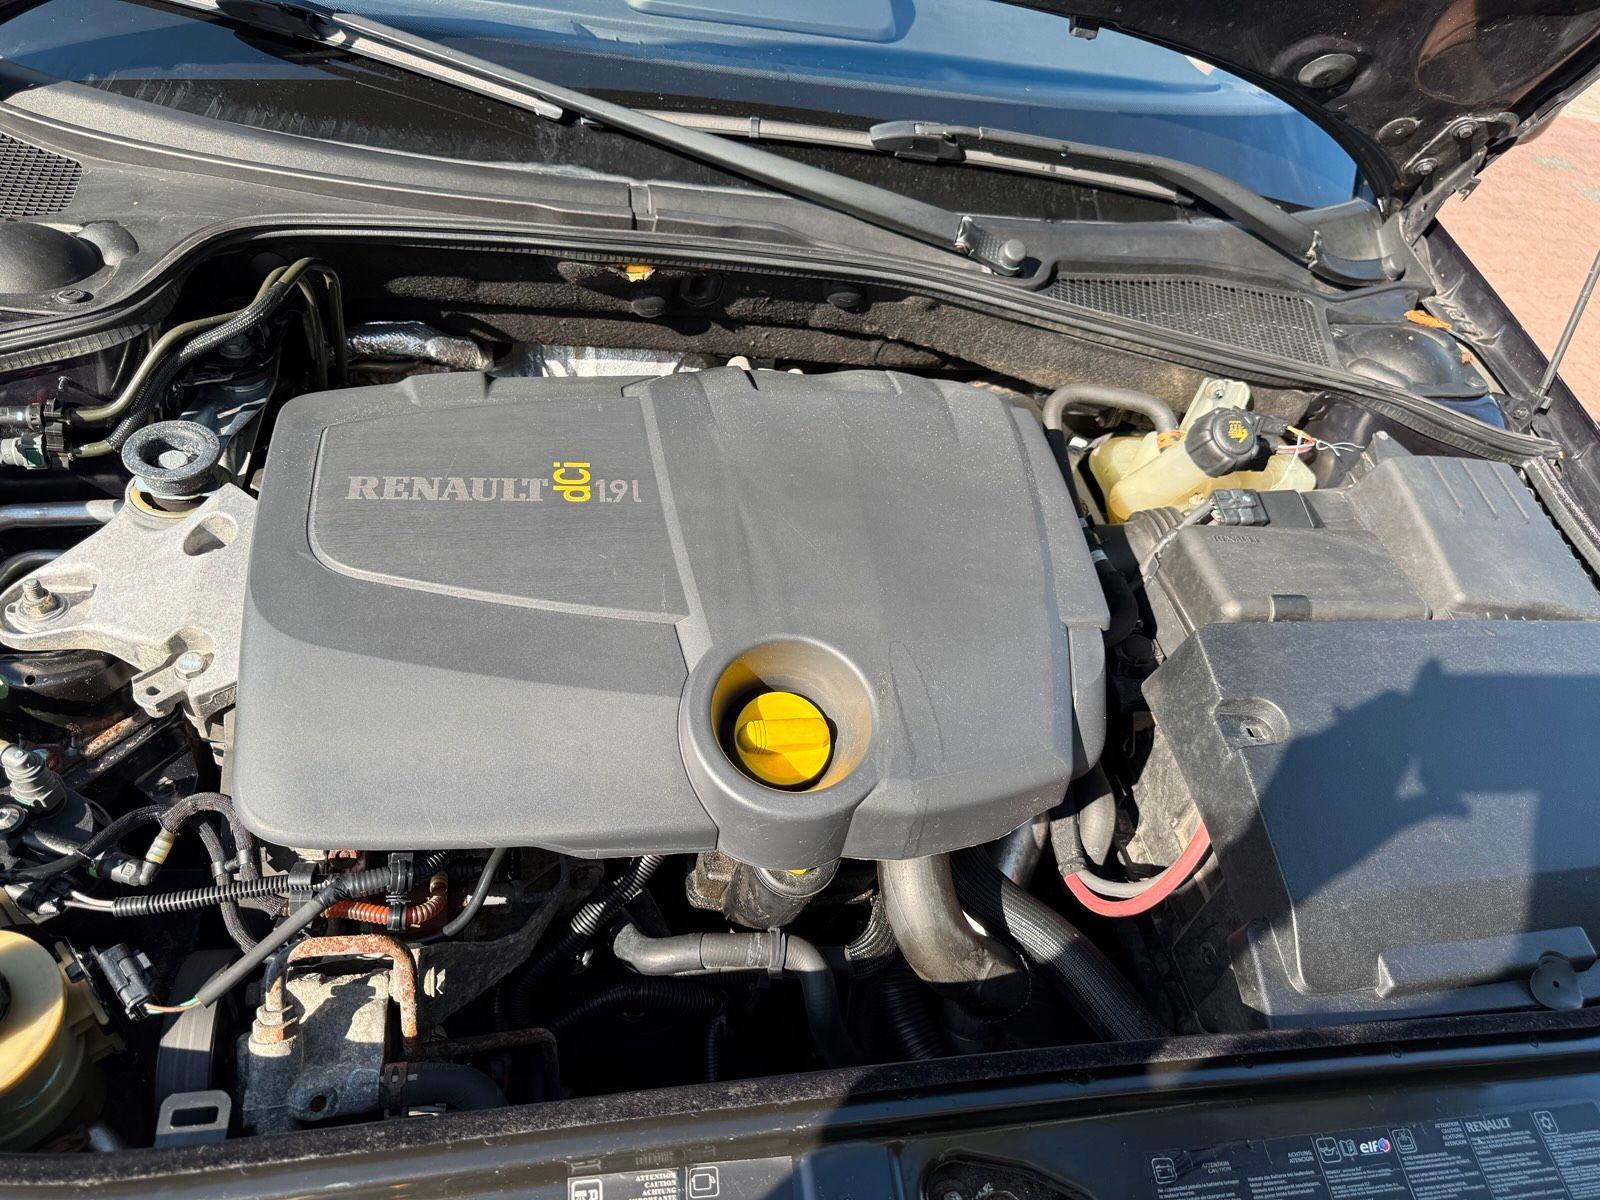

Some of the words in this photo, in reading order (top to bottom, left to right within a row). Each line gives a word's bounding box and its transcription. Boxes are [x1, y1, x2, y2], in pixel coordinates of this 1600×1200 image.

[344, 475, 549, 503] RENAULT
[552, 461, 592, 503] dCi
[1434, 1121, 1460, 1129] ATTENTION
[1441, 1126, 1462, 1134] CAUTION
[1464, 1117, 1512, 1133] RENAULT
[1359, 1140, 1380, 1154] elf
[1287, 1150, 1313, 1158] ACHTUNG
[1200, 1160, 1230, 1169] ATTENTION
[635, 1171, 677, 1182] ATTENTION
[644, 1179, 677, 1189] CAUTION
[641, 1187, 677, 1197] ACHTUNG
